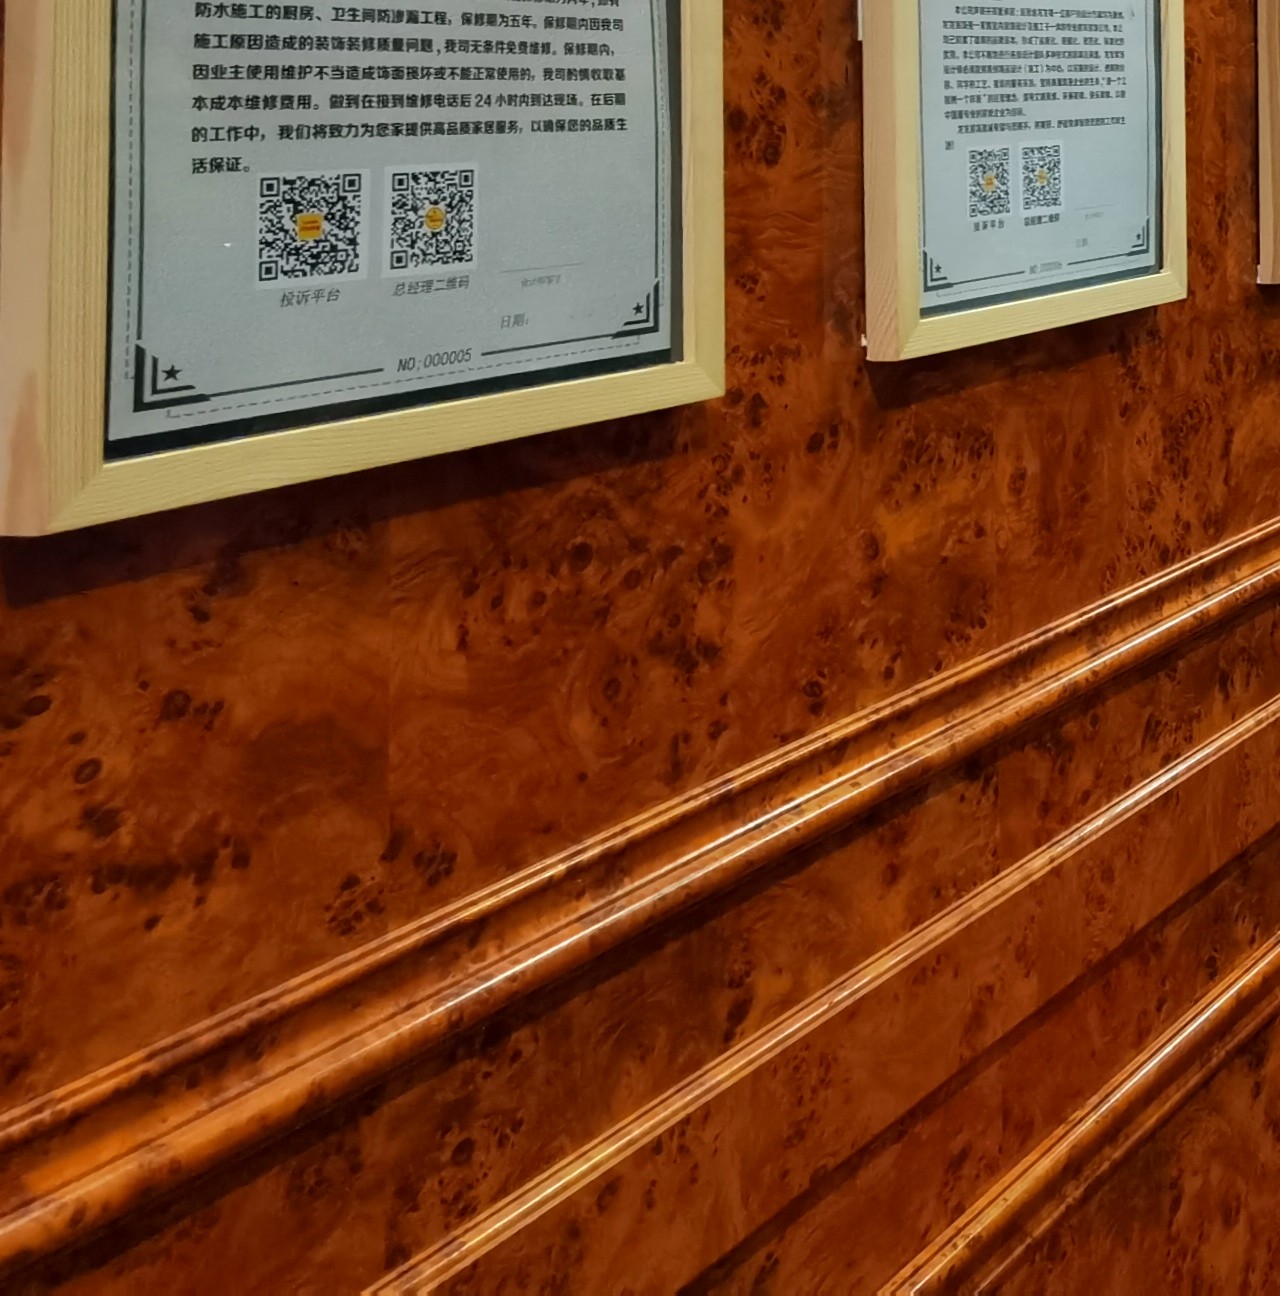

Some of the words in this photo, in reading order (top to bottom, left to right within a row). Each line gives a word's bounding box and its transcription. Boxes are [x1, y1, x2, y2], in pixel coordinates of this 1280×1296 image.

[280, 288, 341, 308] 投诉平台
[393, 275, 470, 298] 总经理二维码
